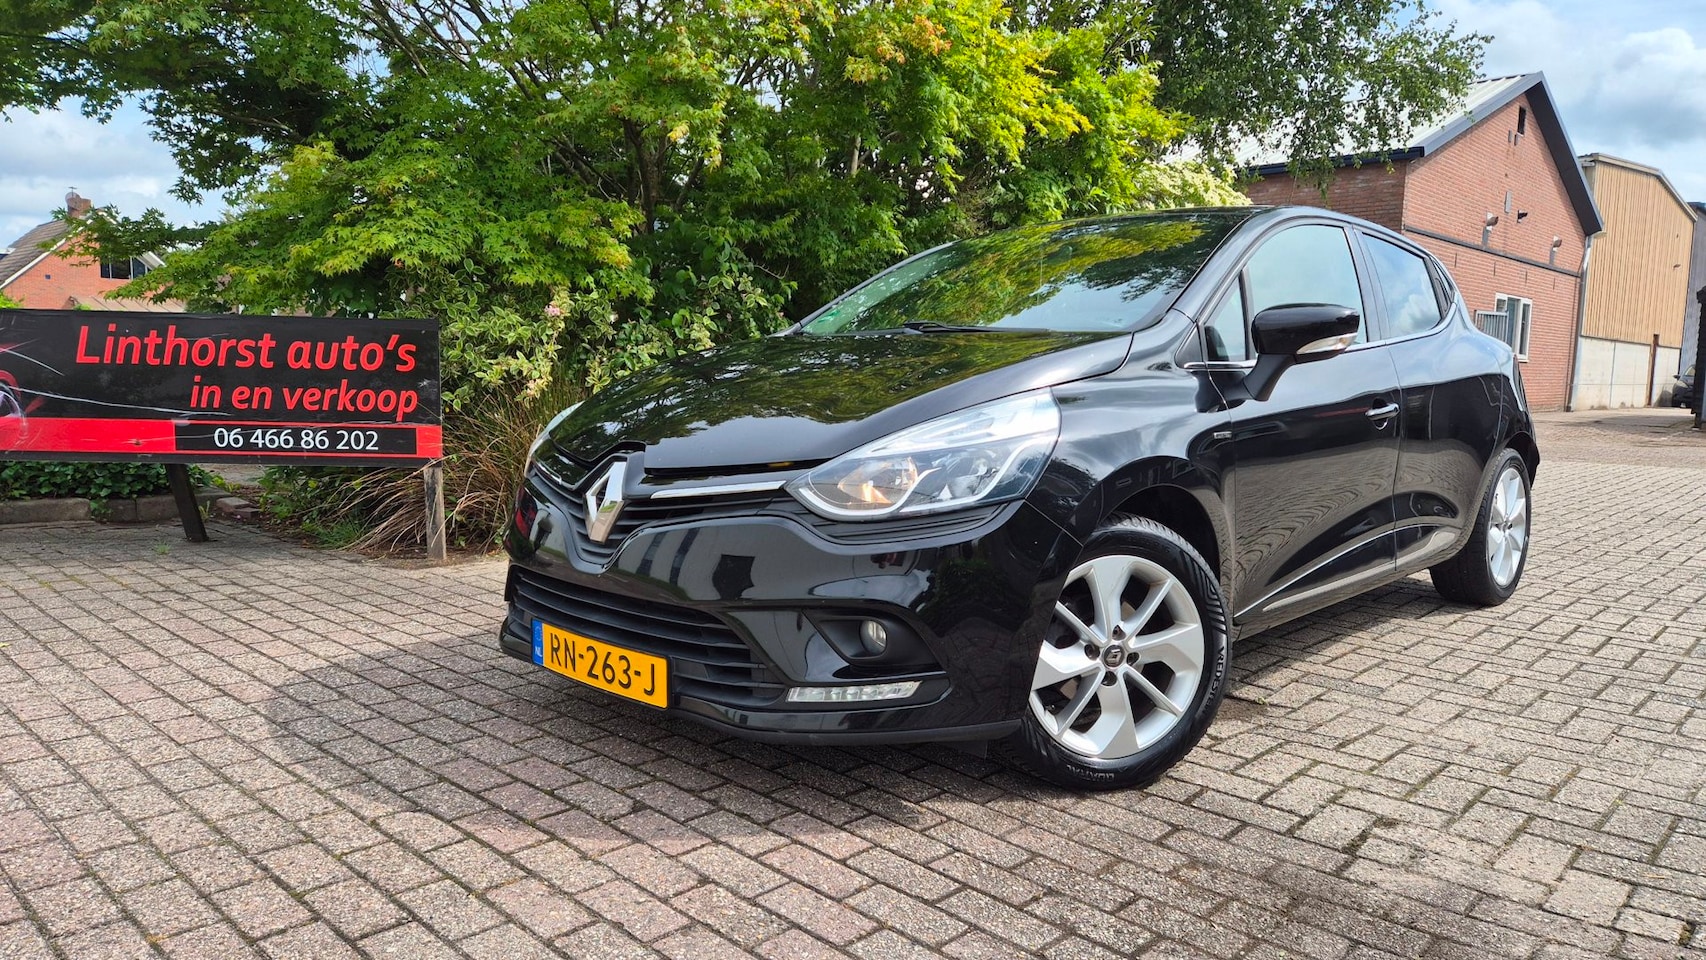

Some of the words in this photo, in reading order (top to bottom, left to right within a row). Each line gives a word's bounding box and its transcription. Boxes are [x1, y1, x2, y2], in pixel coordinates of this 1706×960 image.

[76, 324, 276, 368] Linthorst
[287, 335, 416, 371] auto’s
[191, 376, 221, 408] in
[232, 386, 272, 409] en
[283, 379, 418, 421] verkoop
[214, 428, 243, 447] 06
[250, 429, 293, 448] 466
[301, 430, 329, 449] 86
[336, 430, 378, 450] 202
[550, 632, 655, 696] RN-263-J
